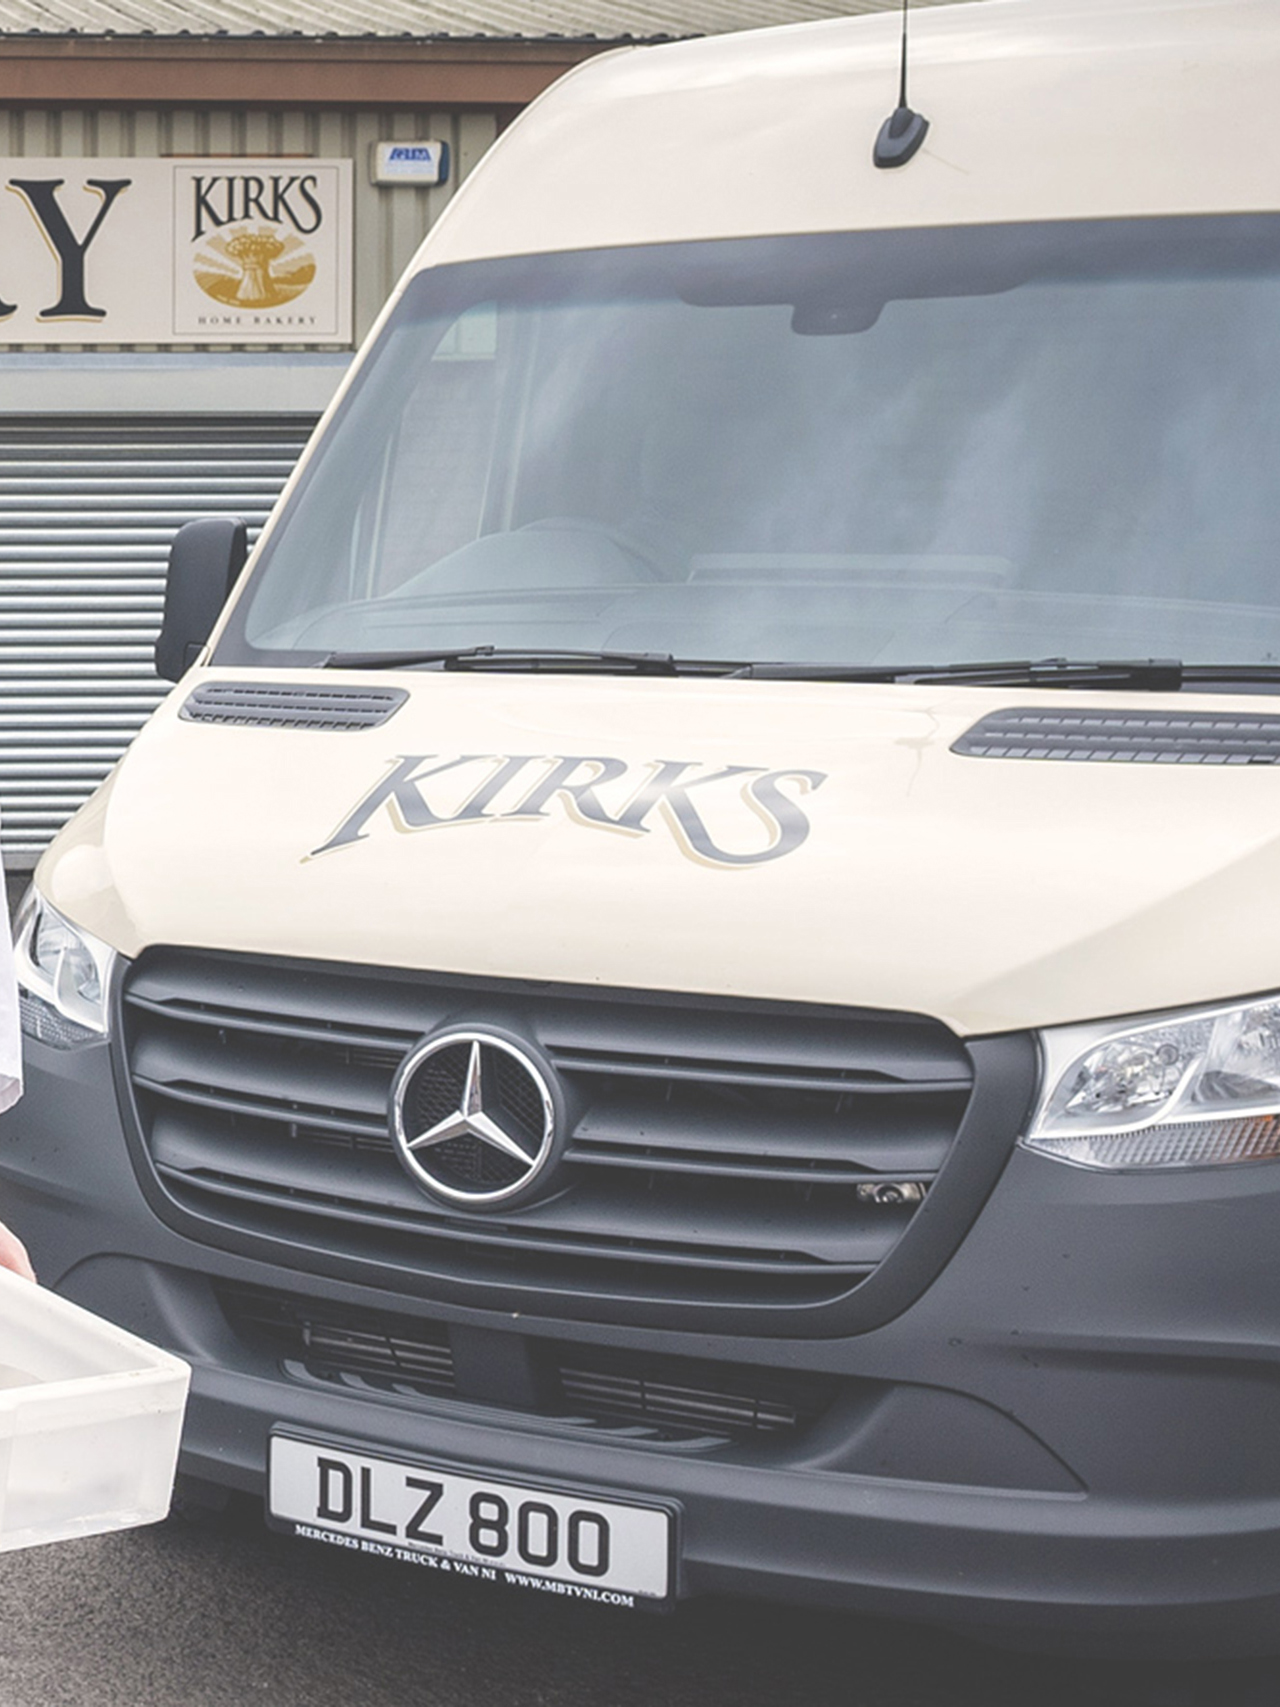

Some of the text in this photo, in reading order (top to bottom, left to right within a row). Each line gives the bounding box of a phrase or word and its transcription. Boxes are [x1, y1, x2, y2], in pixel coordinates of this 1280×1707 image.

[191, 174, 323, 242] KIRKS
[198, 316, 316, 325] HOME BAKERY
[299, 754, 829, 871] KIRKS
[316, 1456, 611, 1578] DLZ 800
[295, 1524, 359, 1550] MERCEDES
[361, 1541, 394, 1558] BENZ
[395, 1549, 438, 1568] TRUCK
[440, 1559, 452, 1571] &
[452, 1562, 479, 1577] VAN
[481, 1567, 496, 1581] NI
[504, 1572, 635, 1607] WWW.MBTVNI.COM
